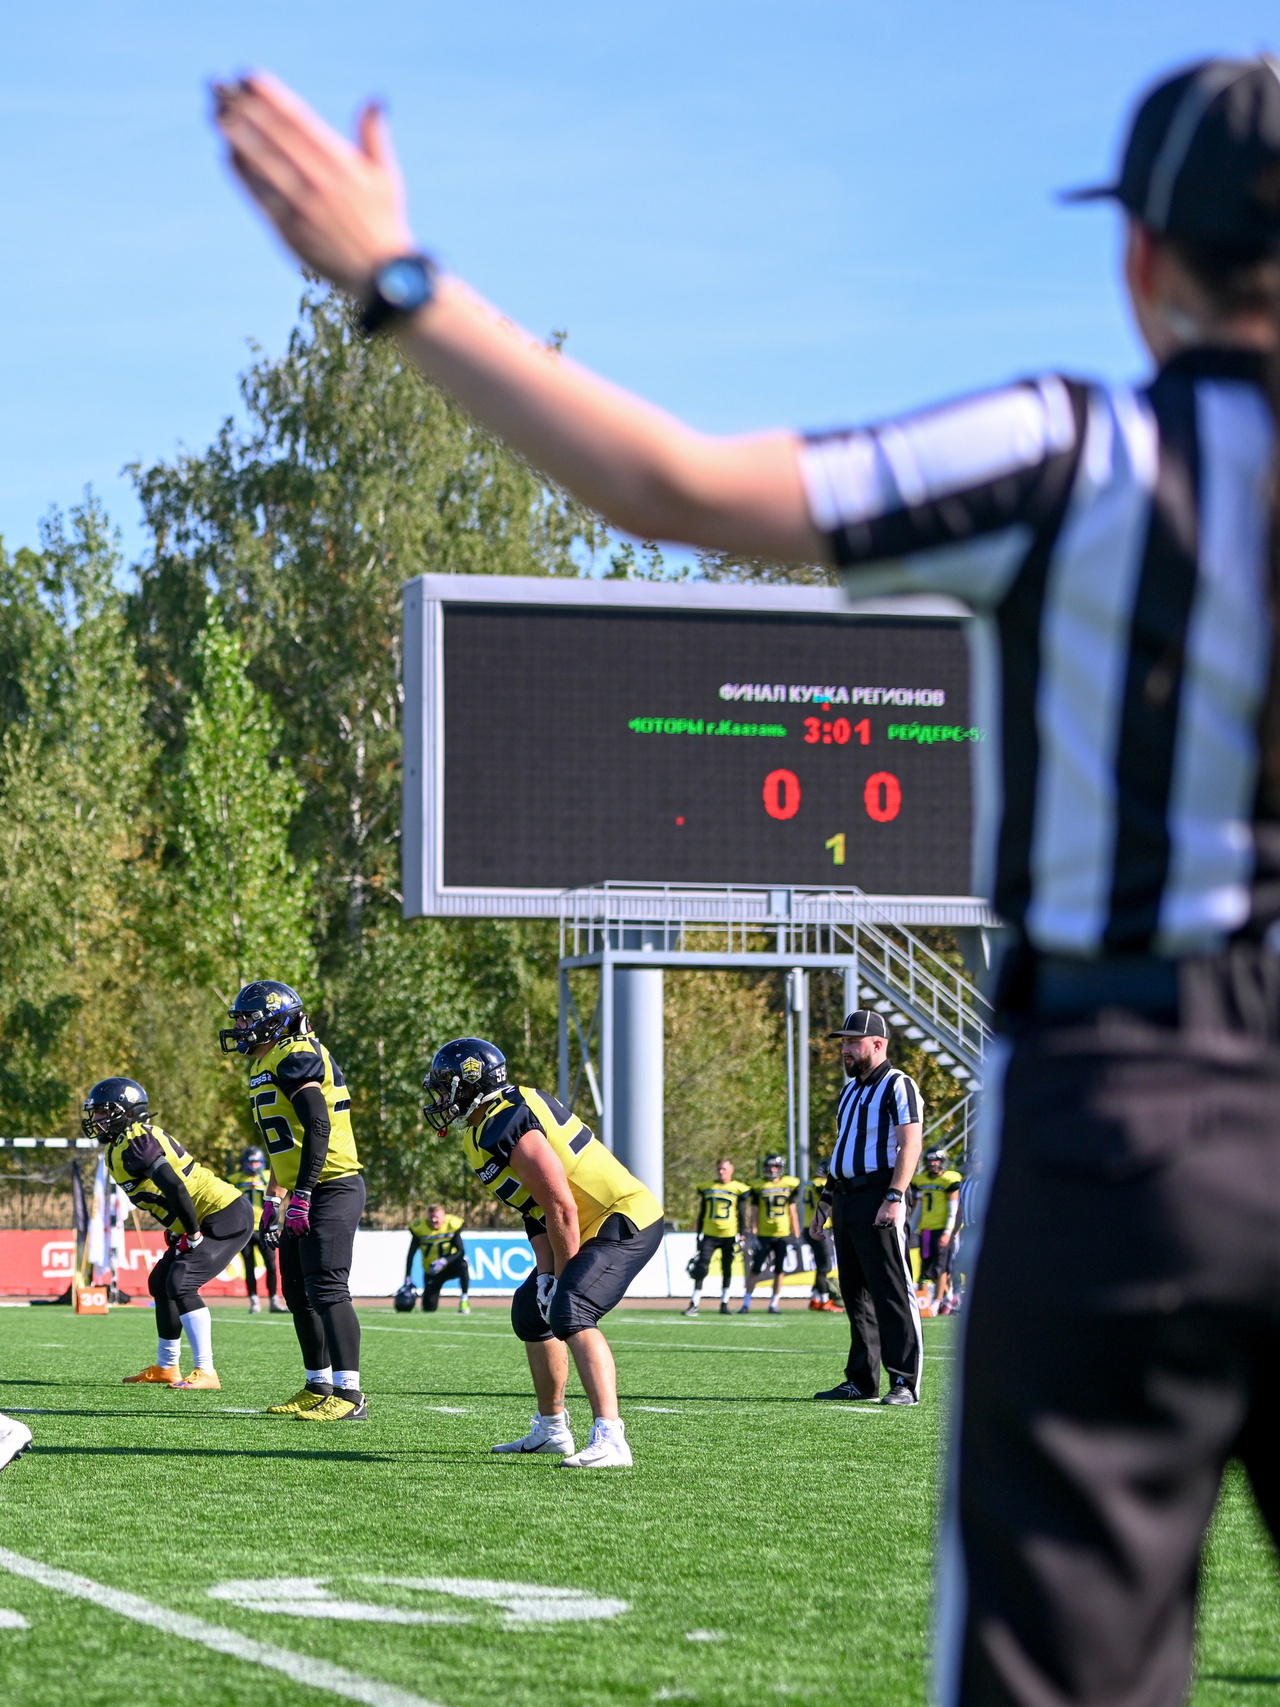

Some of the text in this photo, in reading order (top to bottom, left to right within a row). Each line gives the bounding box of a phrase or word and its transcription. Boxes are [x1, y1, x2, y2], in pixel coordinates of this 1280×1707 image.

[719, 683, 945, 707] ФИНАЛ КУБКА РЕГИОНОВ
[803, 716, 871, 745] 3:01
[763, 769, 902, 823] 0 0
[825, 833, 846, 865] 1
[705, 1196, 733, 1220] 13
[80, 1292, 106, 1306] 30
